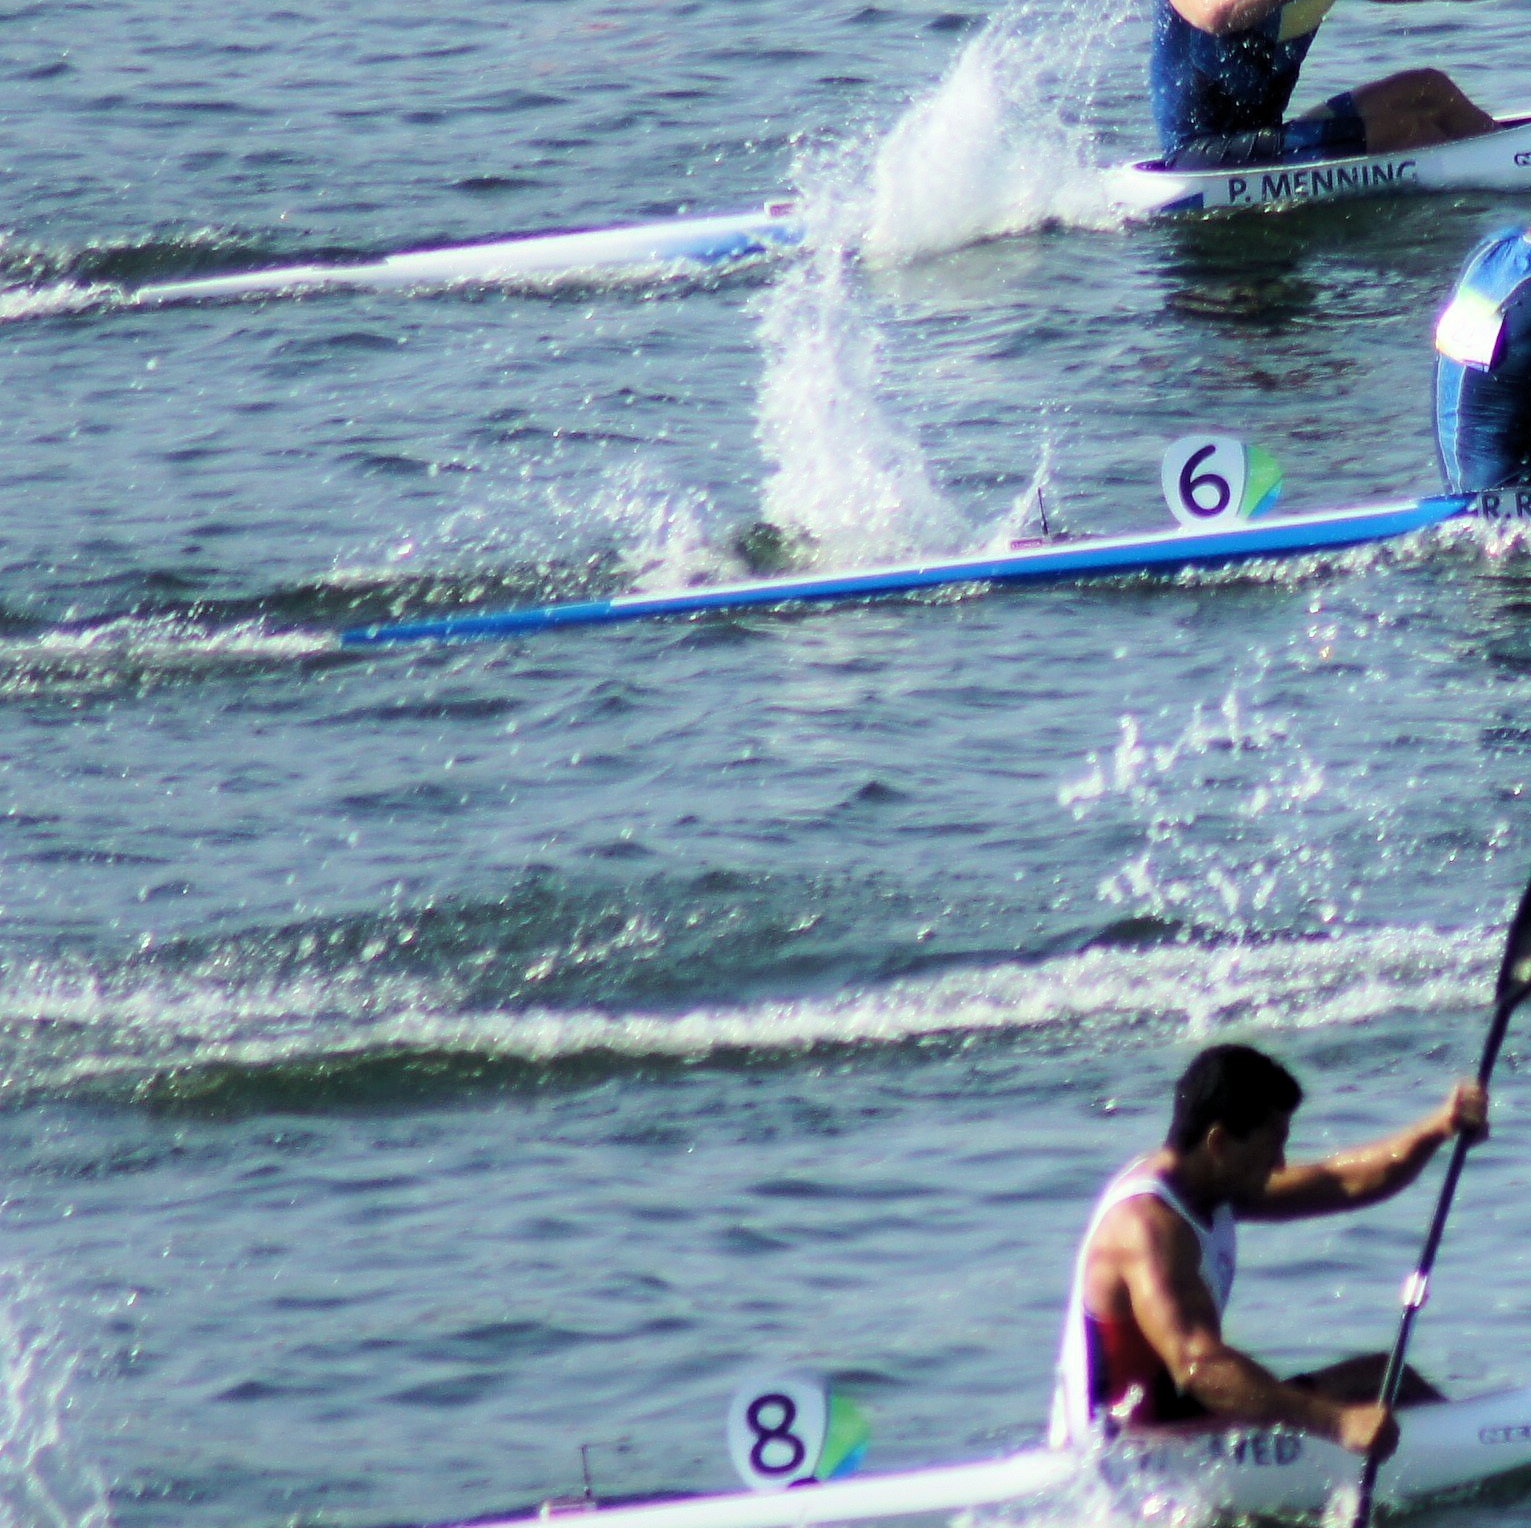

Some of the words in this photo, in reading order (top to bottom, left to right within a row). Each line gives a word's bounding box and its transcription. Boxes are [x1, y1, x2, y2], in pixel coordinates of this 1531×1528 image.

[1228, 176, 1251, 203] P.
[1179, 444, 1231, 519] 6
[1481, 492, 1511, 519] R.
[746, 1393, 805, 1476] 8
